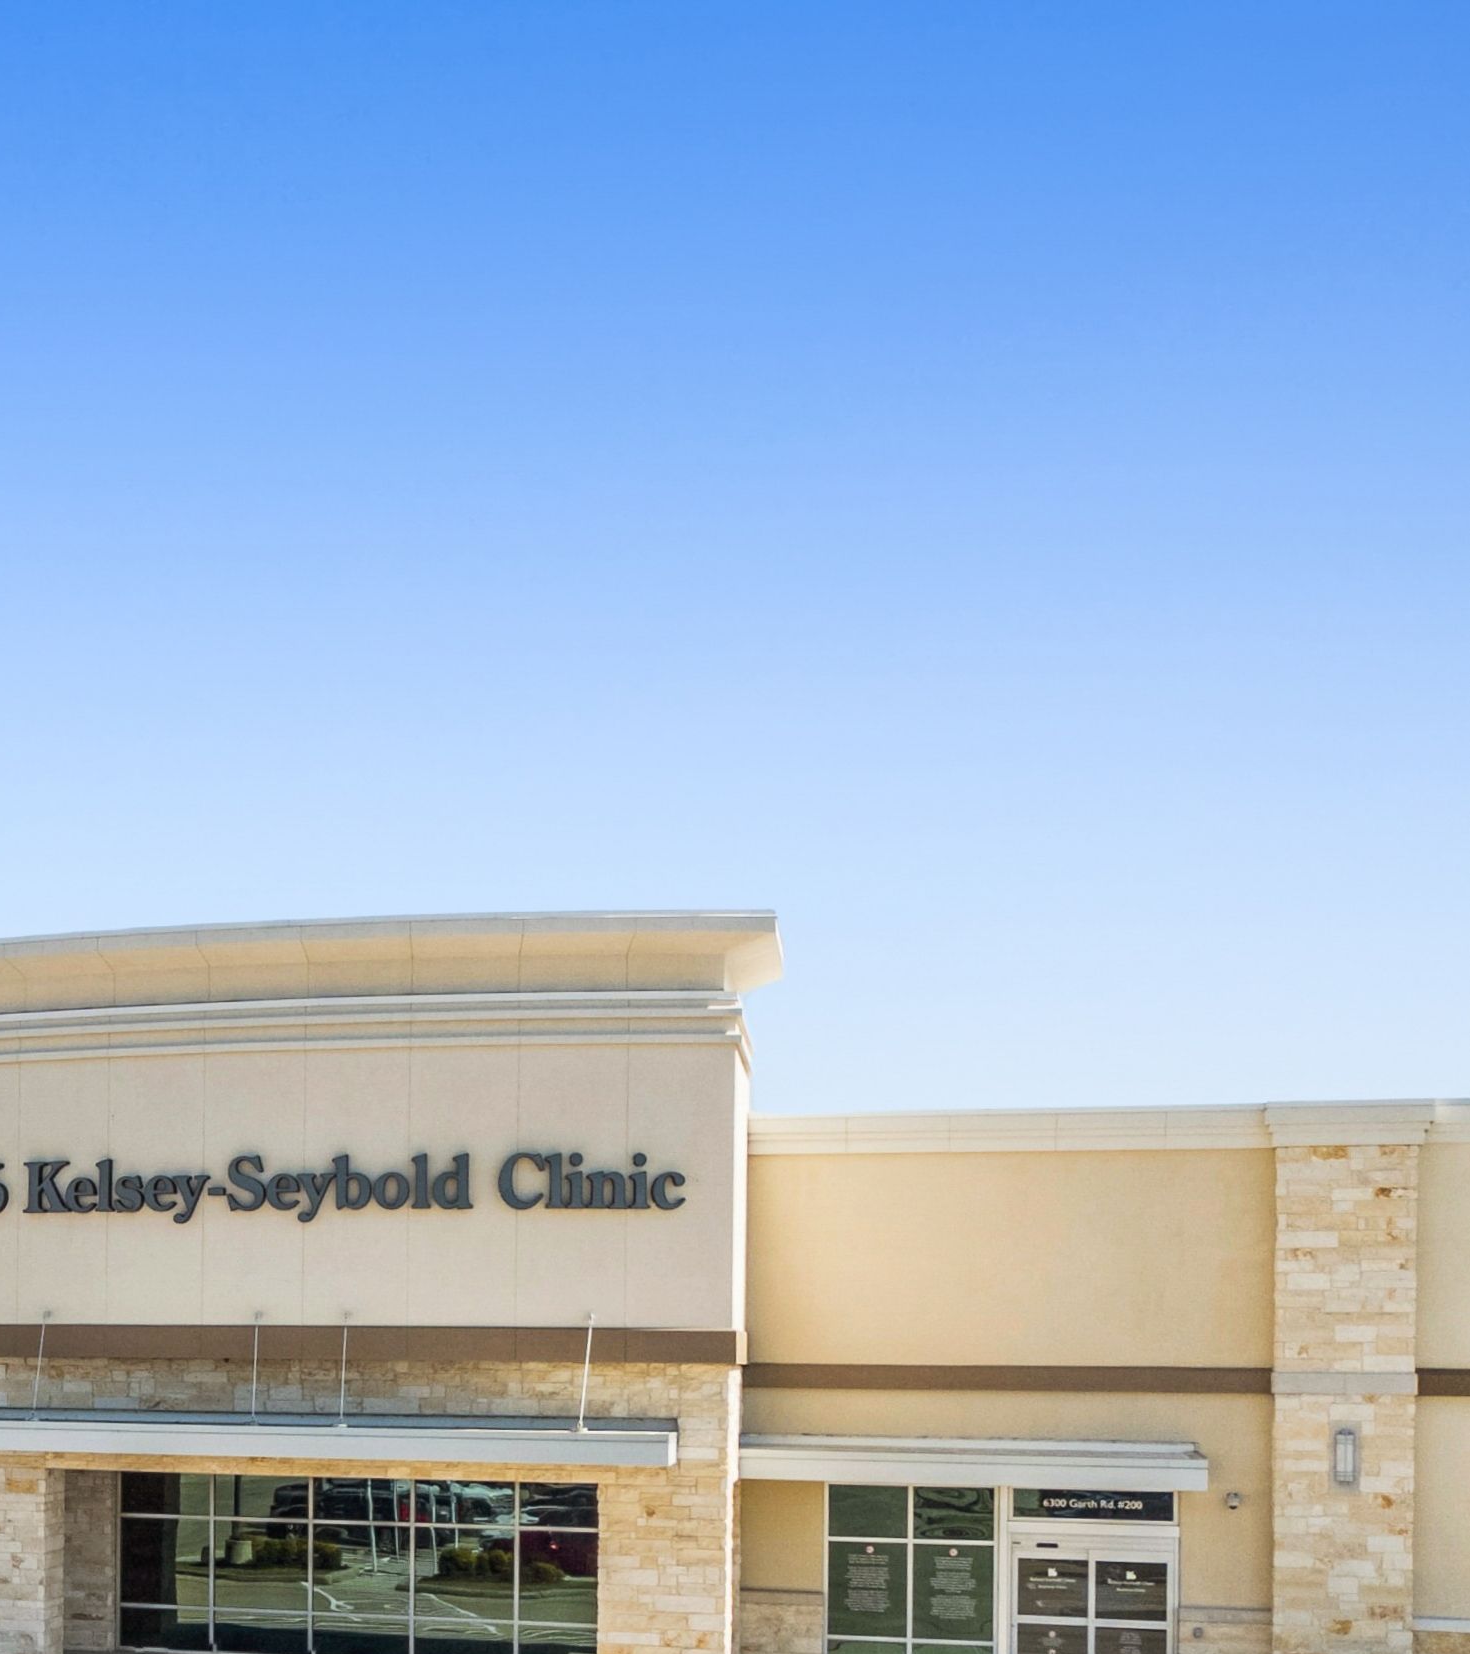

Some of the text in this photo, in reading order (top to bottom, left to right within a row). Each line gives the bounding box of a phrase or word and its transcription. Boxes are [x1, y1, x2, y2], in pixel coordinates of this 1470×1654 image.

[22, 1152, 686, 1224] Kelsey-Seybold Clinic
[1042, 1498, 1143, 1510] 6300 Garth Rd. #200
